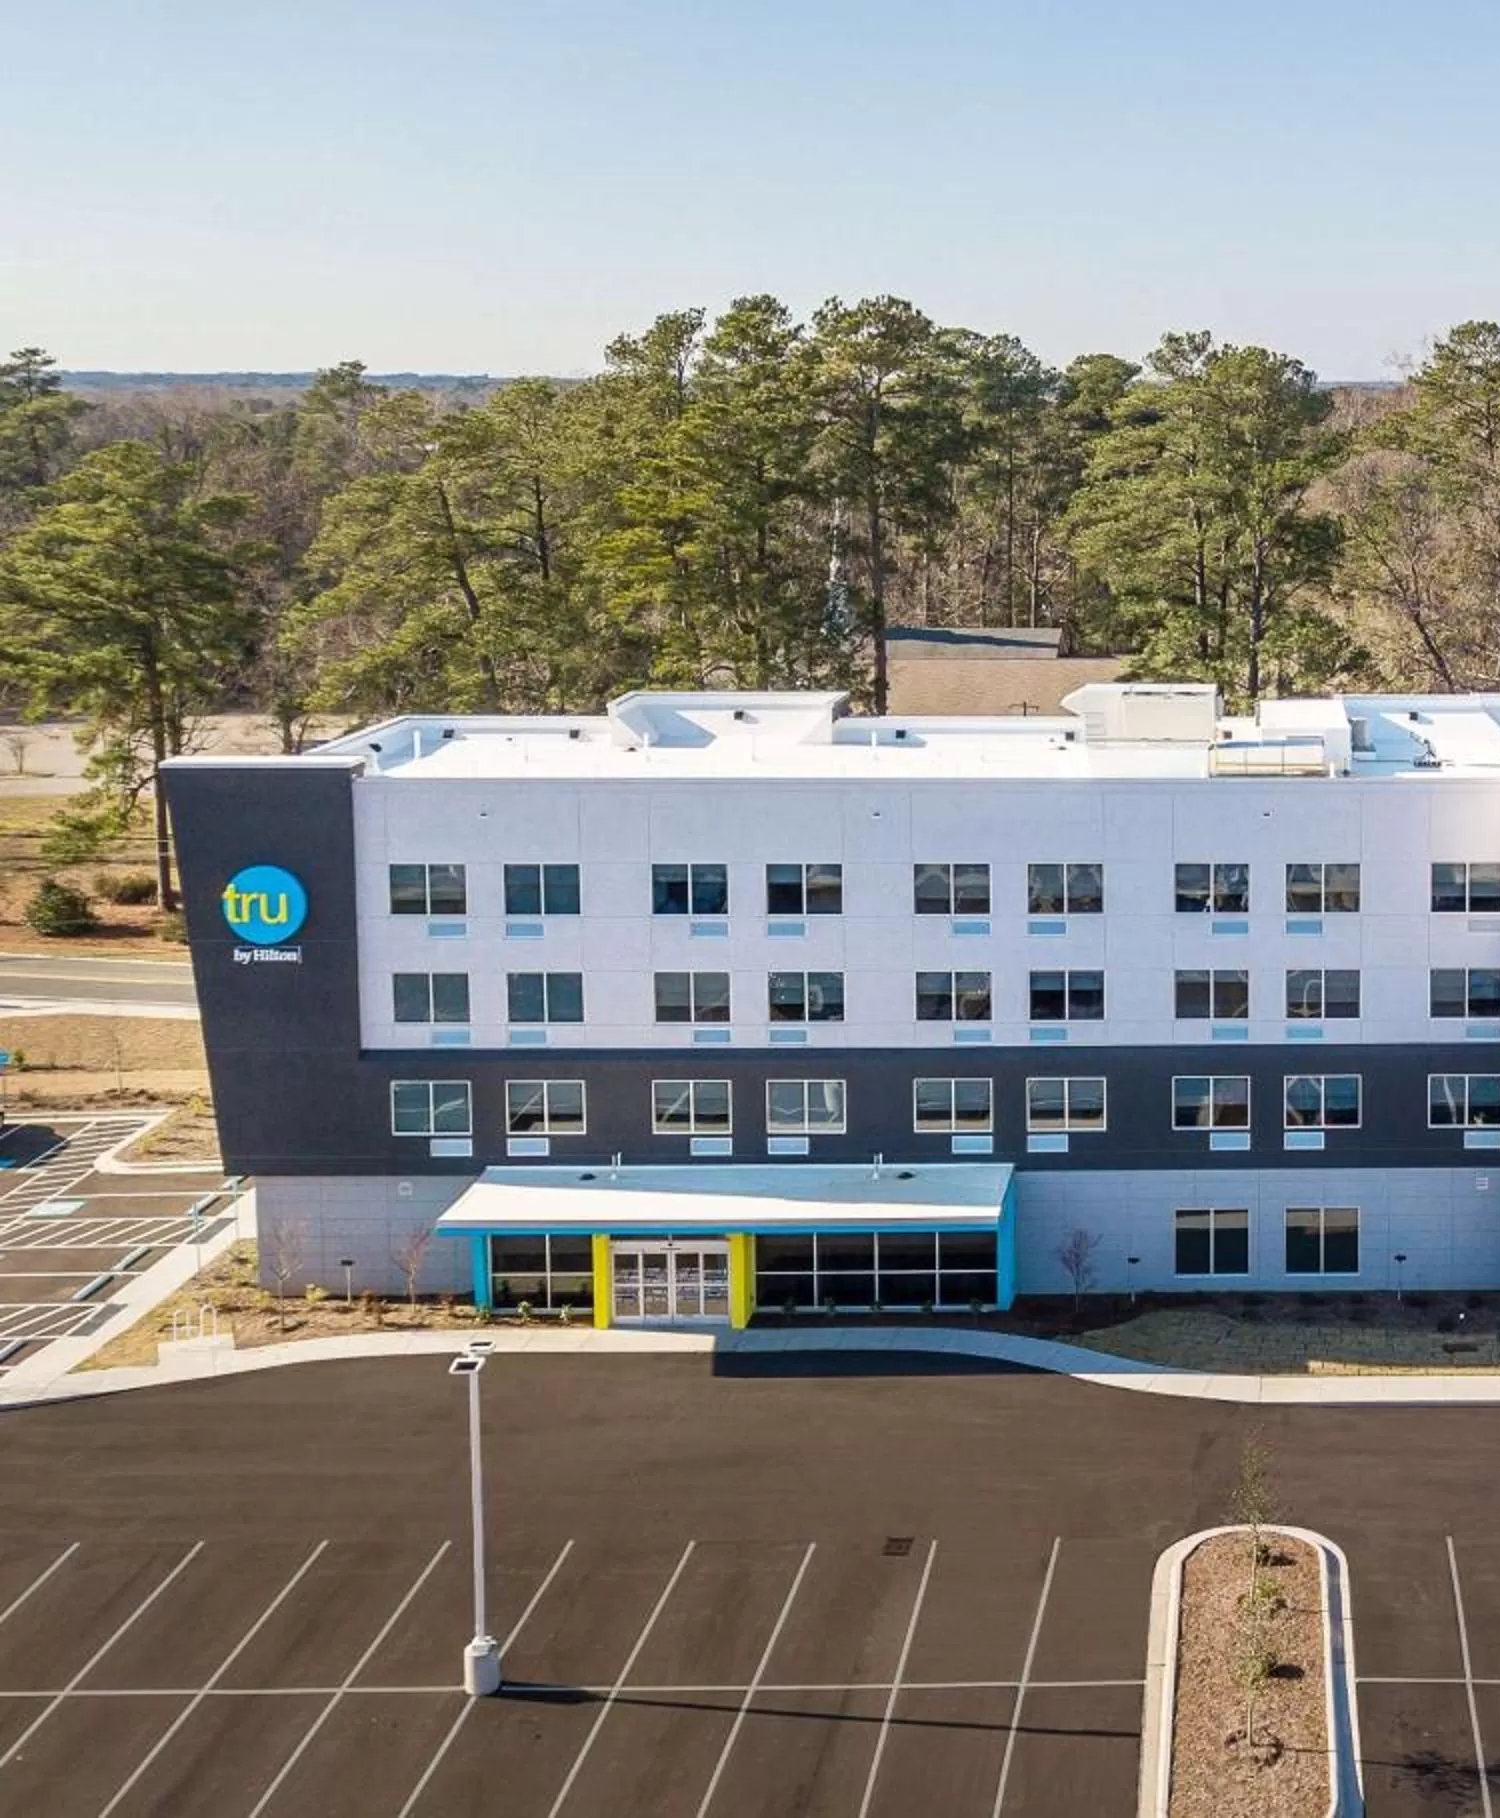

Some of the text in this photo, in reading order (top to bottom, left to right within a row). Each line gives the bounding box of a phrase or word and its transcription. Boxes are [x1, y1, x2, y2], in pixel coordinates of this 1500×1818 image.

[222, 883, 288, 924] tru
[233, 948, 297, 964] by Hilton
